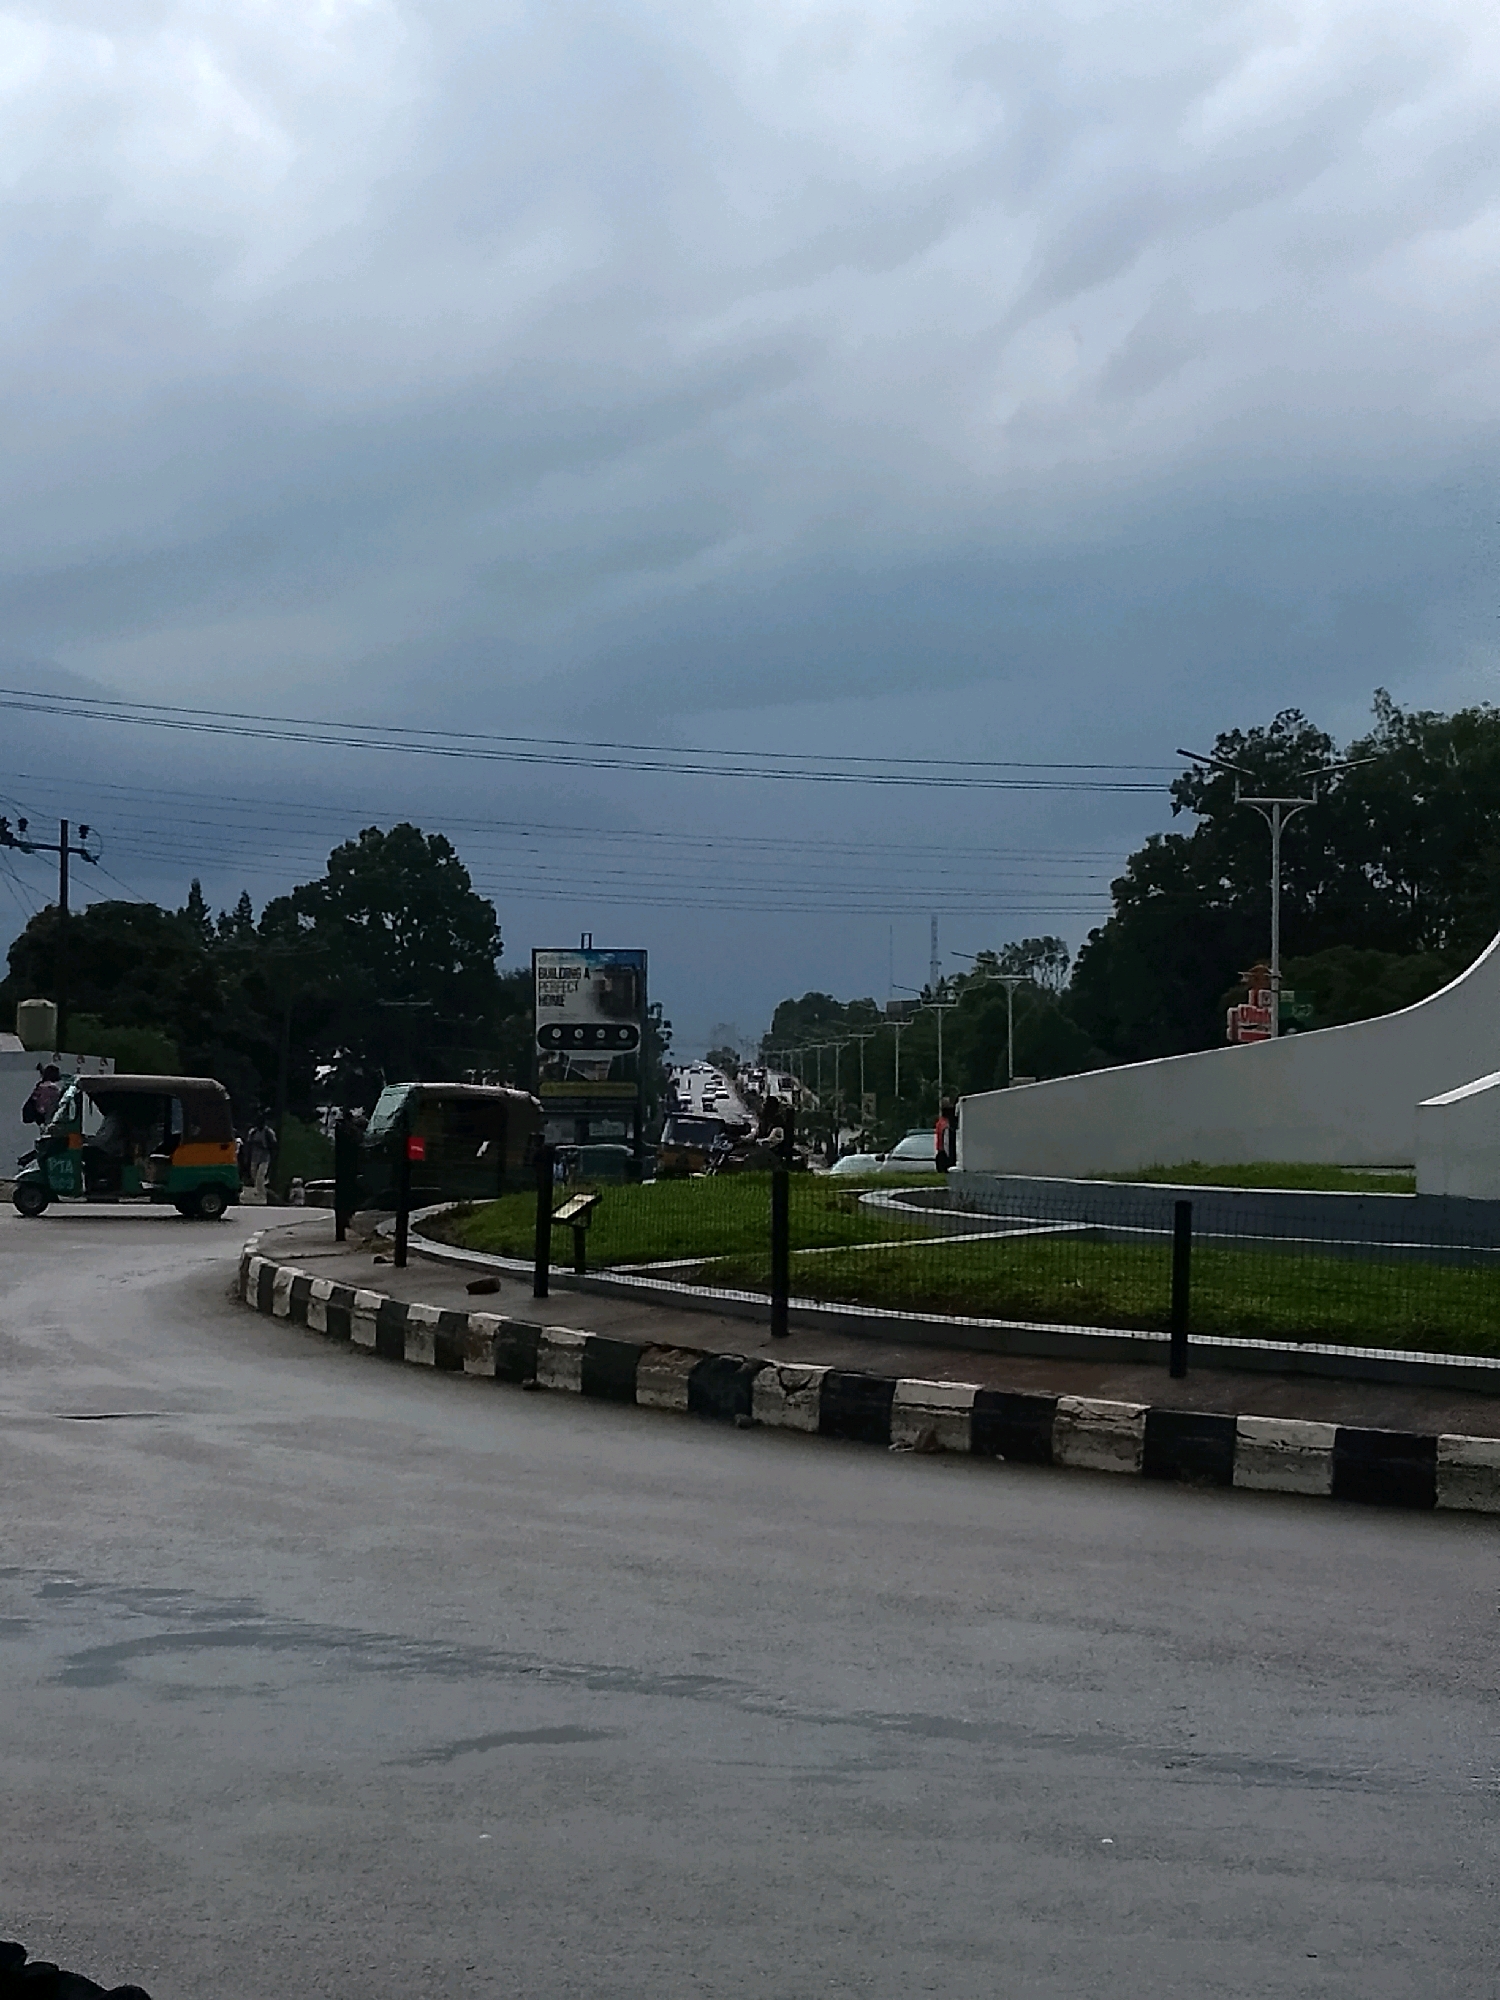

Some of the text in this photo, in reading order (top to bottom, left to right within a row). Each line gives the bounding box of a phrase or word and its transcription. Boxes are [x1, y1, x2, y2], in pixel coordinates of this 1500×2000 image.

[539, 967, 591, 980] BUILDING A
[539, 980, 578, 993] PERFECT
